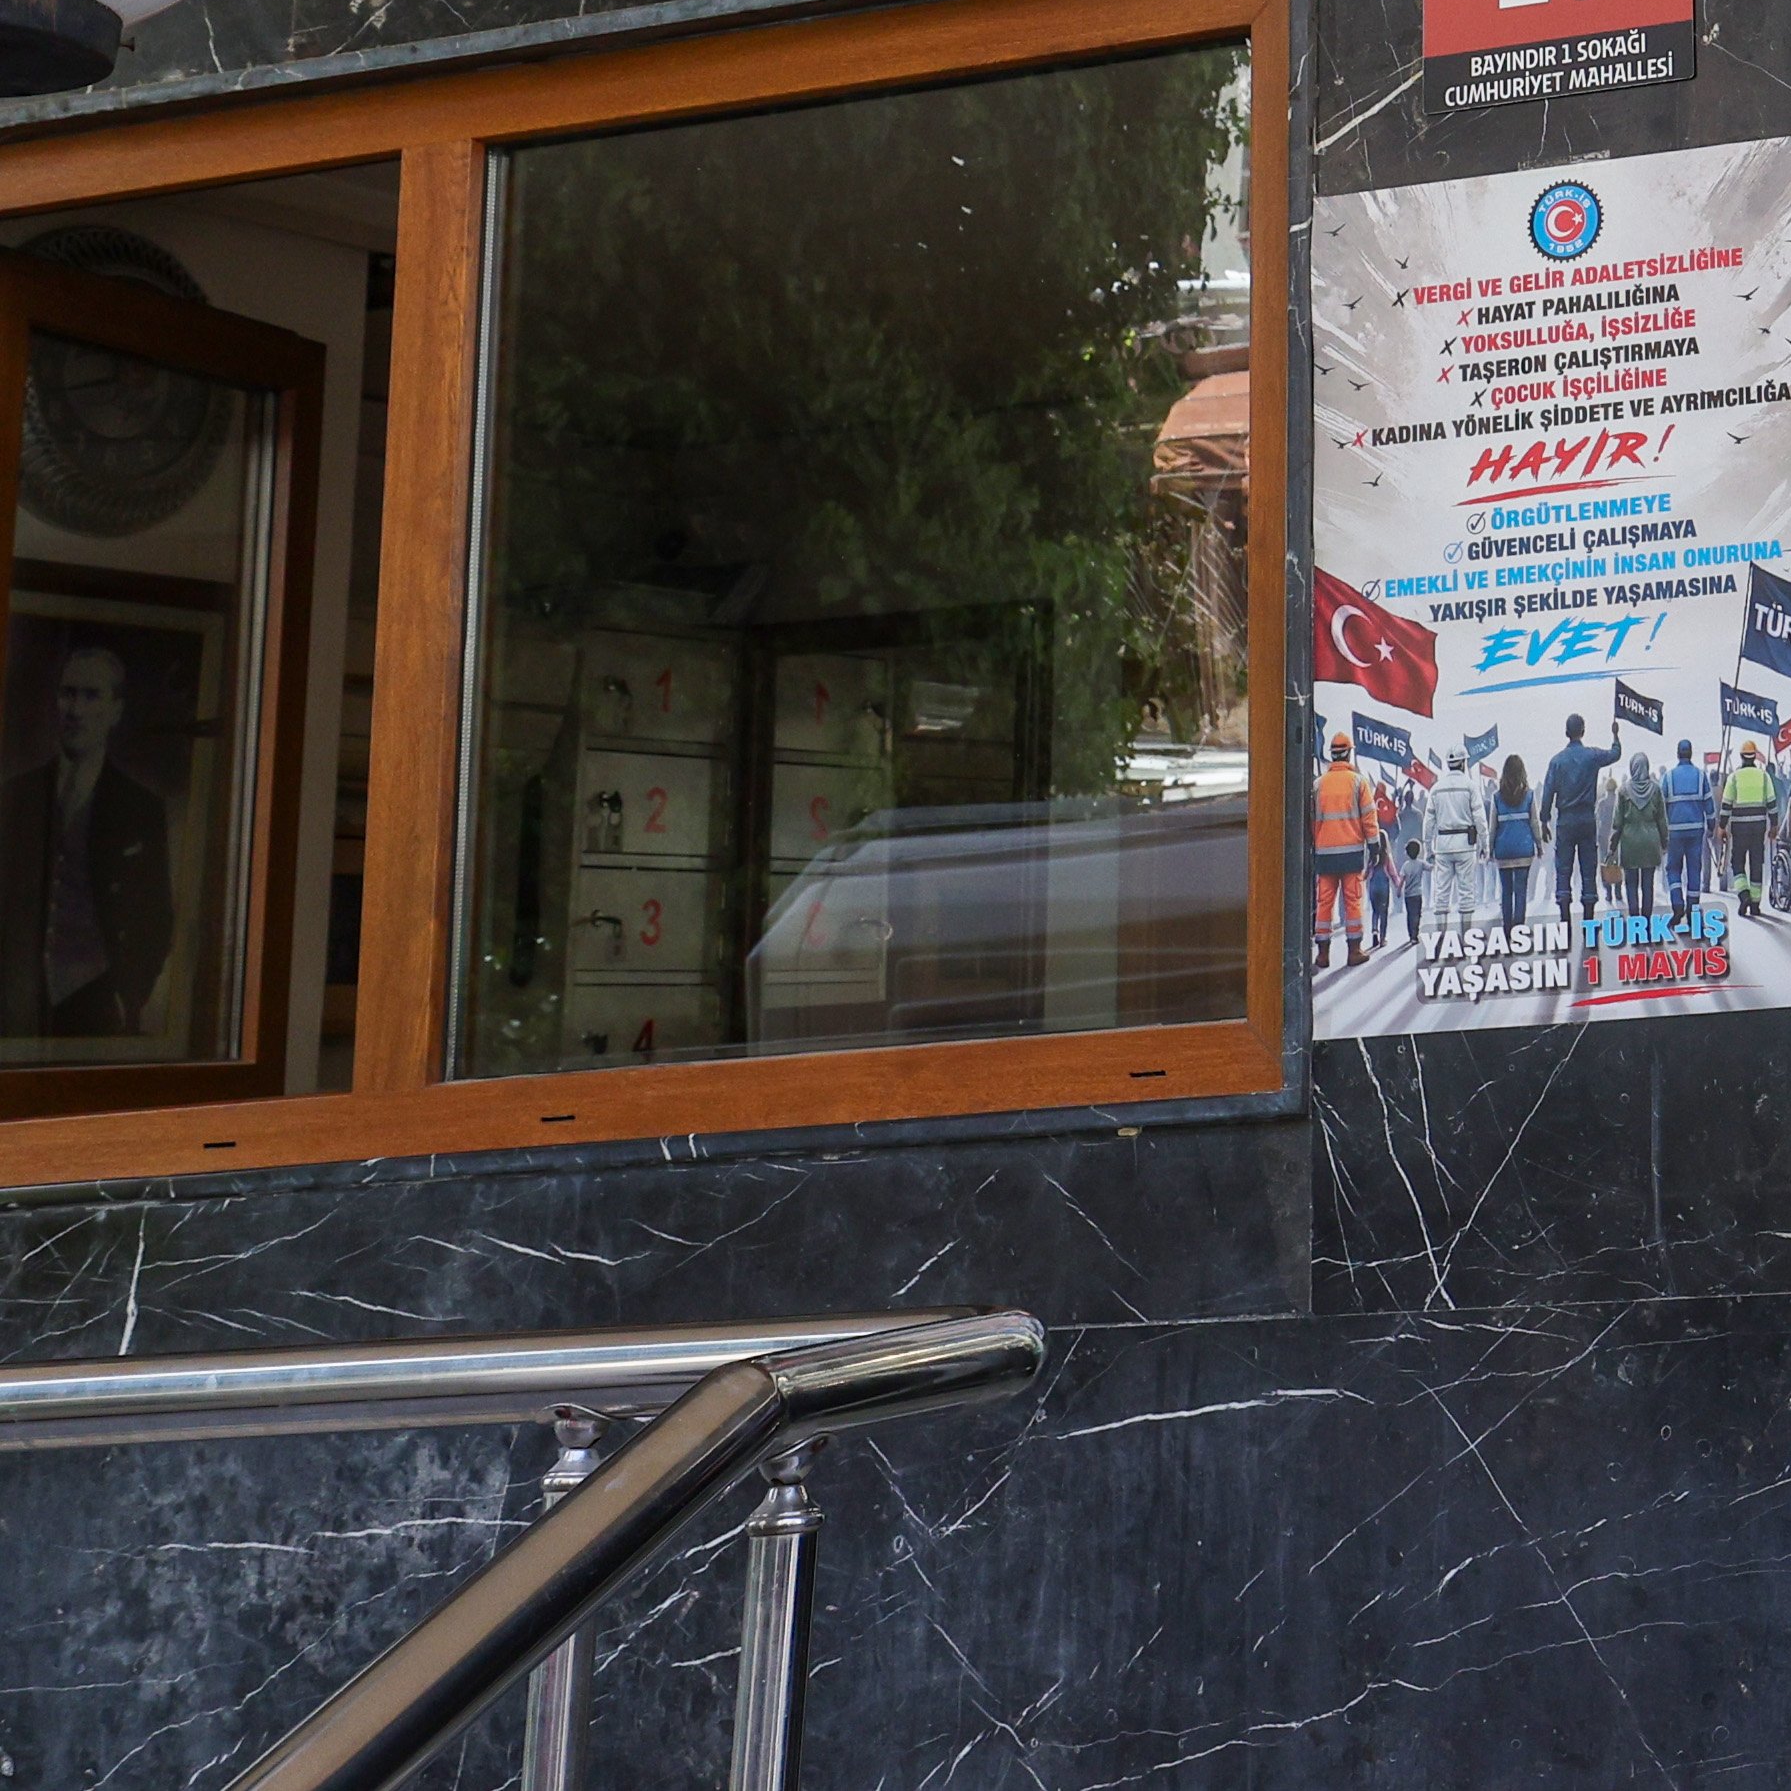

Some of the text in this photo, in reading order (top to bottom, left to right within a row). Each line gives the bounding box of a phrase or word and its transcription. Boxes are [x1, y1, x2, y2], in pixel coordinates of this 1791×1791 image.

[1470, 29, 1646, 77] BAYINDIR 1 SOKAĞI
[1444, 51, 1674, 106] CUMHURİYET MAHALLESİ
[1413, 247, 1743, 305] VERGİ VE GELİR ADALETSİZLİĞİNE
[1477, 284, 1680, 325] HAYAT PAHALILIĞINA
[1461, 306, 1696, 354] YOKSULLUĞA, İŞSİZLİĞE
[1458, 337, 1700, 384] TAŞERON ÇALIŞTIRMAYA
[1491, 367, 1667, 410] ÇOCUK İŞÇİLİĞİNE
[1371, 379, 1791, 447] KADINA YÖNELİK ŞİDDETE VE AYRIMCILIĞA
[1491, 493, 1672, 530] ÖRGÜTLENMEYE
[1467, 519, 1697, 561] GÜVENCELİ ÇALIŞMAYA
[1385, 539, 1783, 598] EMEKLİ VE EMEKÇİNİN İNSAN ONURUNA
[1429, 574, 1738, 623] YAKIŞIR ŞEKİLDE YAŞAMASINA
[656, 669, 673, 713] 1
[643, 786, 669, 833] 2
[640, 898, 664, 946] 3
[1419, 904, 1726, 964] YAŞASIN TÜRK-İŞ
[1417, 946, 1728, 1000] YAŞASIN 1 MAYIS
